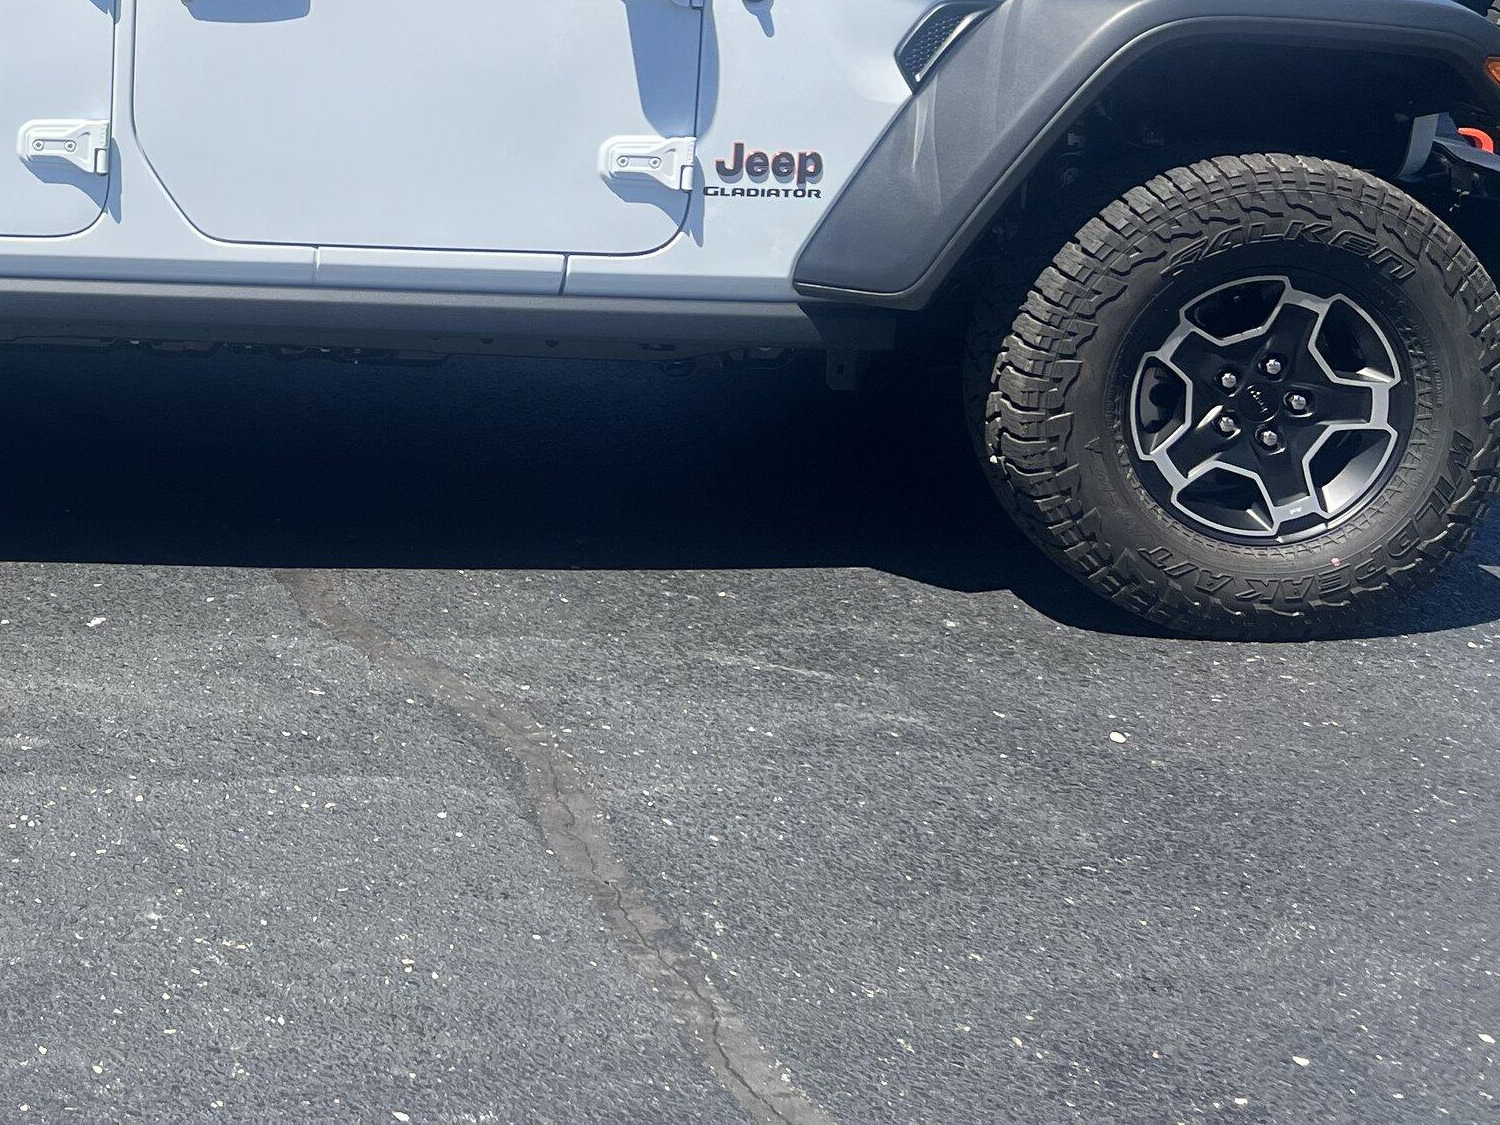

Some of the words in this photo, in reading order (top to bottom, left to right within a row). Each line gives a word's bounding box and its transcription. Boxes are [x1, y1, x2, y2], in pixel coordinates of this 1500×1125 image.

[714, 141, 824, 186] Jeep
[703, 186, 822, 199] GLADIATOR
[1159, 220, 1417, 279] FALKEN
